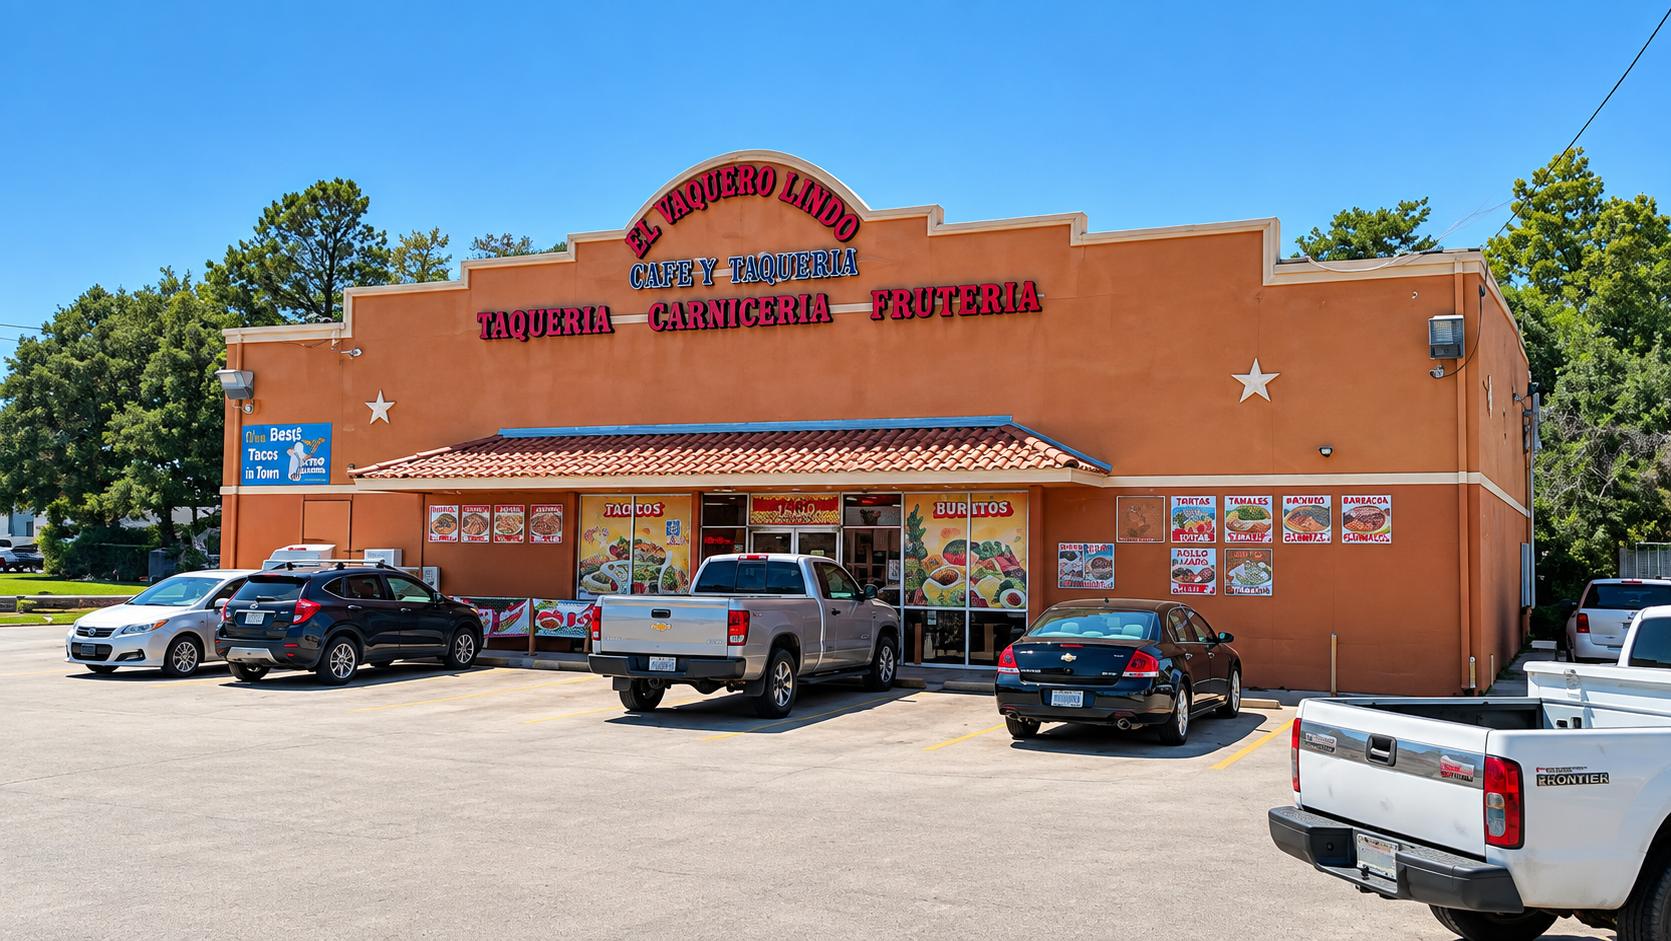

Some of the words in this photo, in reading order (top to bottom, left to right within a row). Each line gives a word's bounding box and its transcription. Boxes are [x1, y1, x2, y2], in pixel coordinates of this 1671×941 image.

[624, 217, 662, 259] EL
[652, 164, 777, 225] VAQUERO
[778, 171, 860, 242] LINDO
[629, 259, 694, 290] CAFE
[698, 257, 718, 286] Y
[728, 247, 859, 286] TAQUERIA
[477, 305, 615, 342] TAQUERIA
[647, 293, 833, 332] CARNICERIA
[870, 280, 1042, 321] FRUTERIA
[245, 466, 255, 480] in
[248, 448, 279, 461] Tacos
